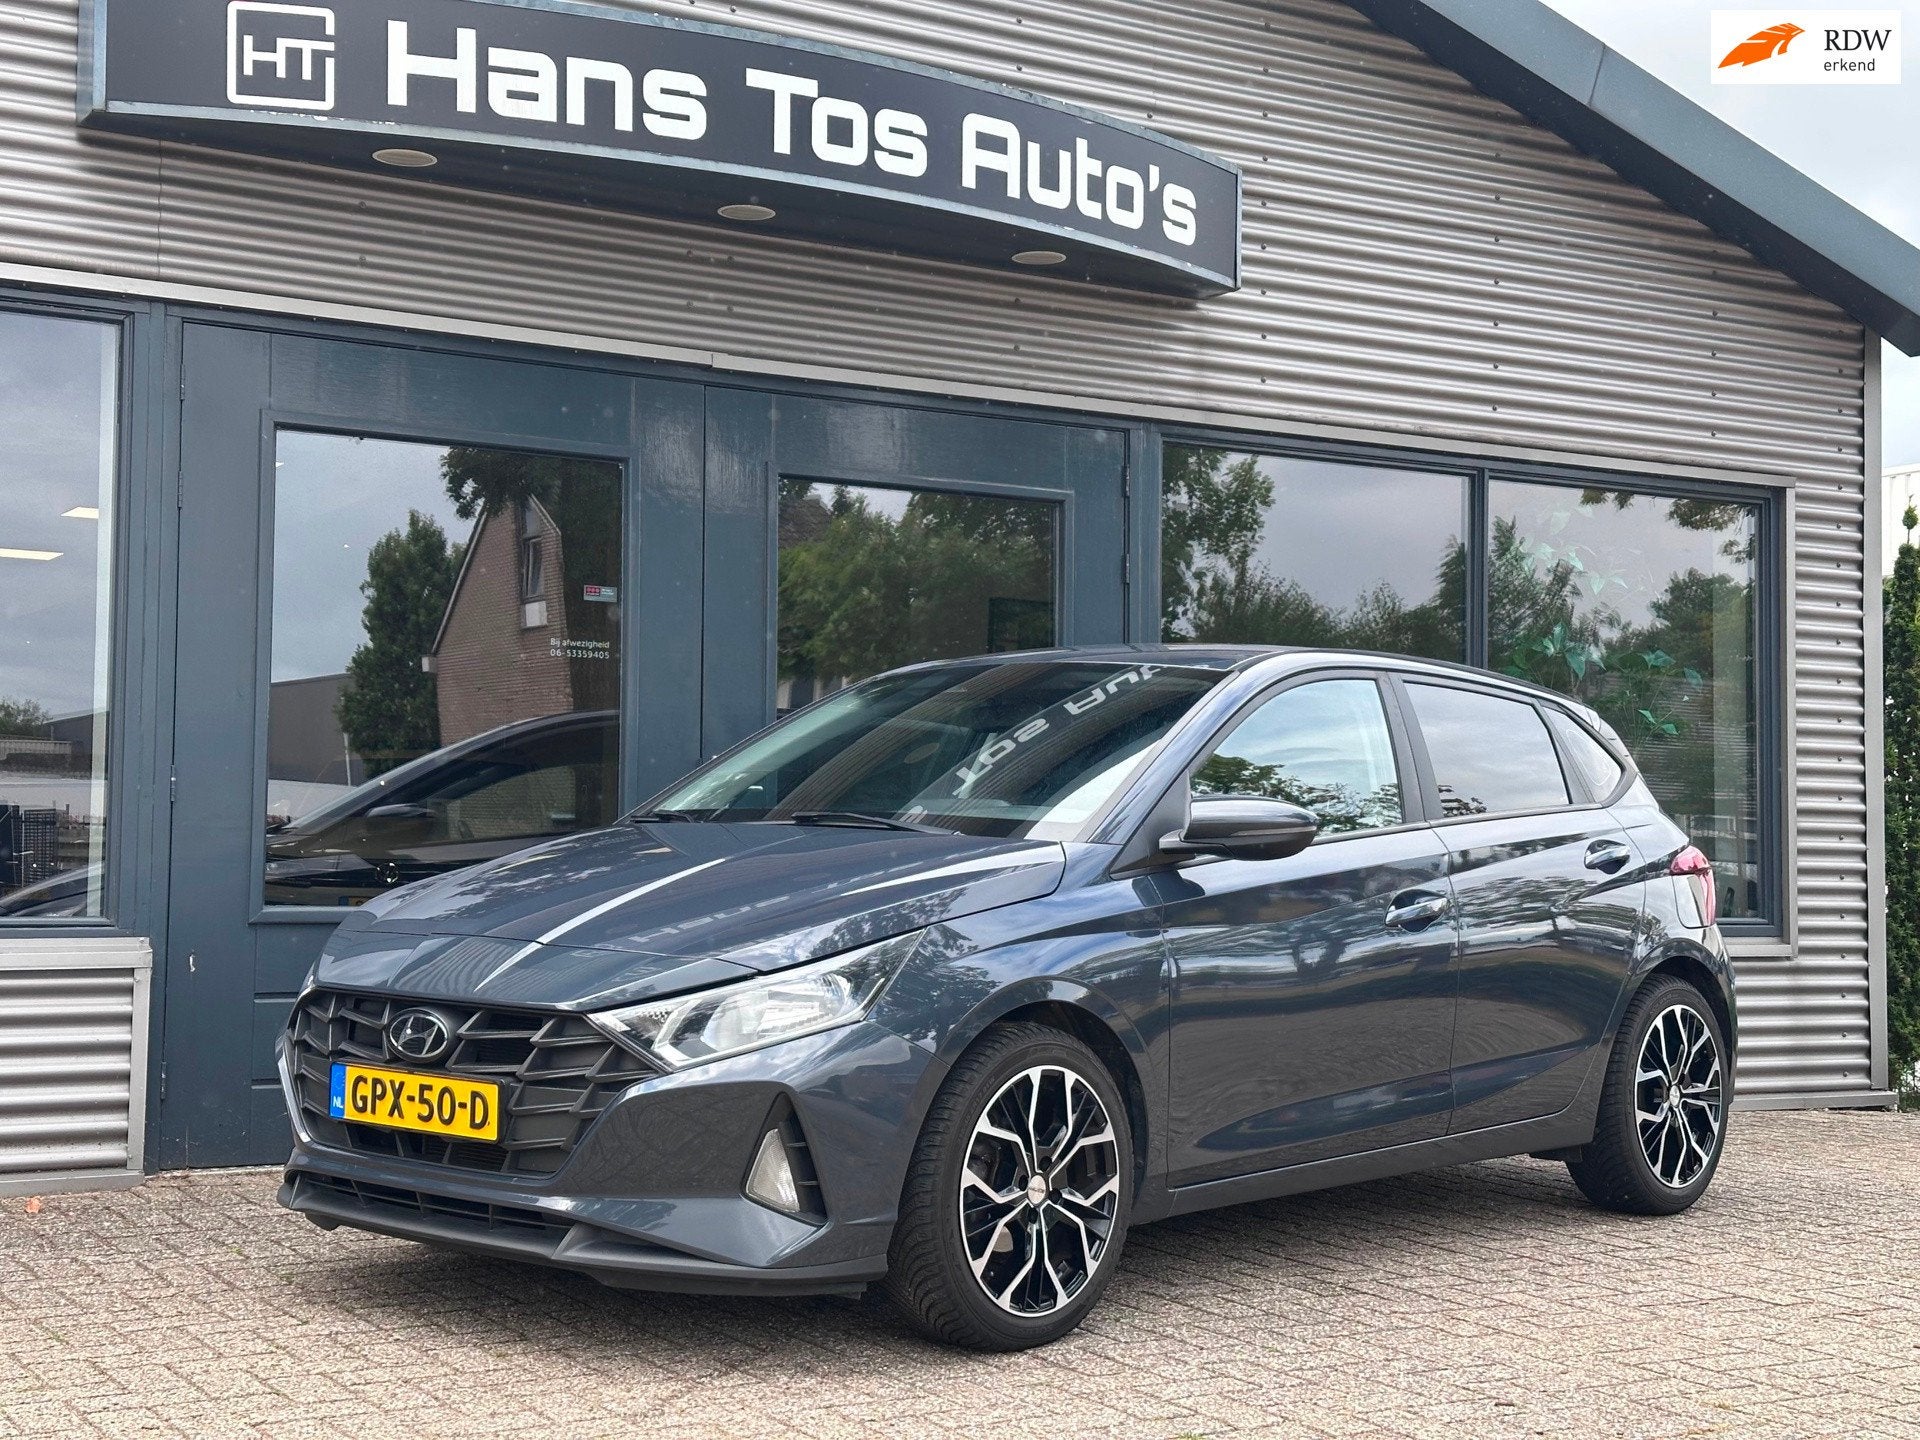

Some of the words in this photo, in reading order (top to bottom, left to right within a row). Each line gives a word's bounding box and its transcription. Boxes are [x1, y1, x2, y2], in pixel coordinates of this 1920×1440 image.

[387, 19, 708, 141] Hans
[745, 67, 929, 178] Tos
[961, 112, 1197, 247] Auto's
[562, 639, 610, 650] afwezigheid
[332, 1096, 344, 1109] NL
[351, 1075, 489, 1130] GPX-50-D
